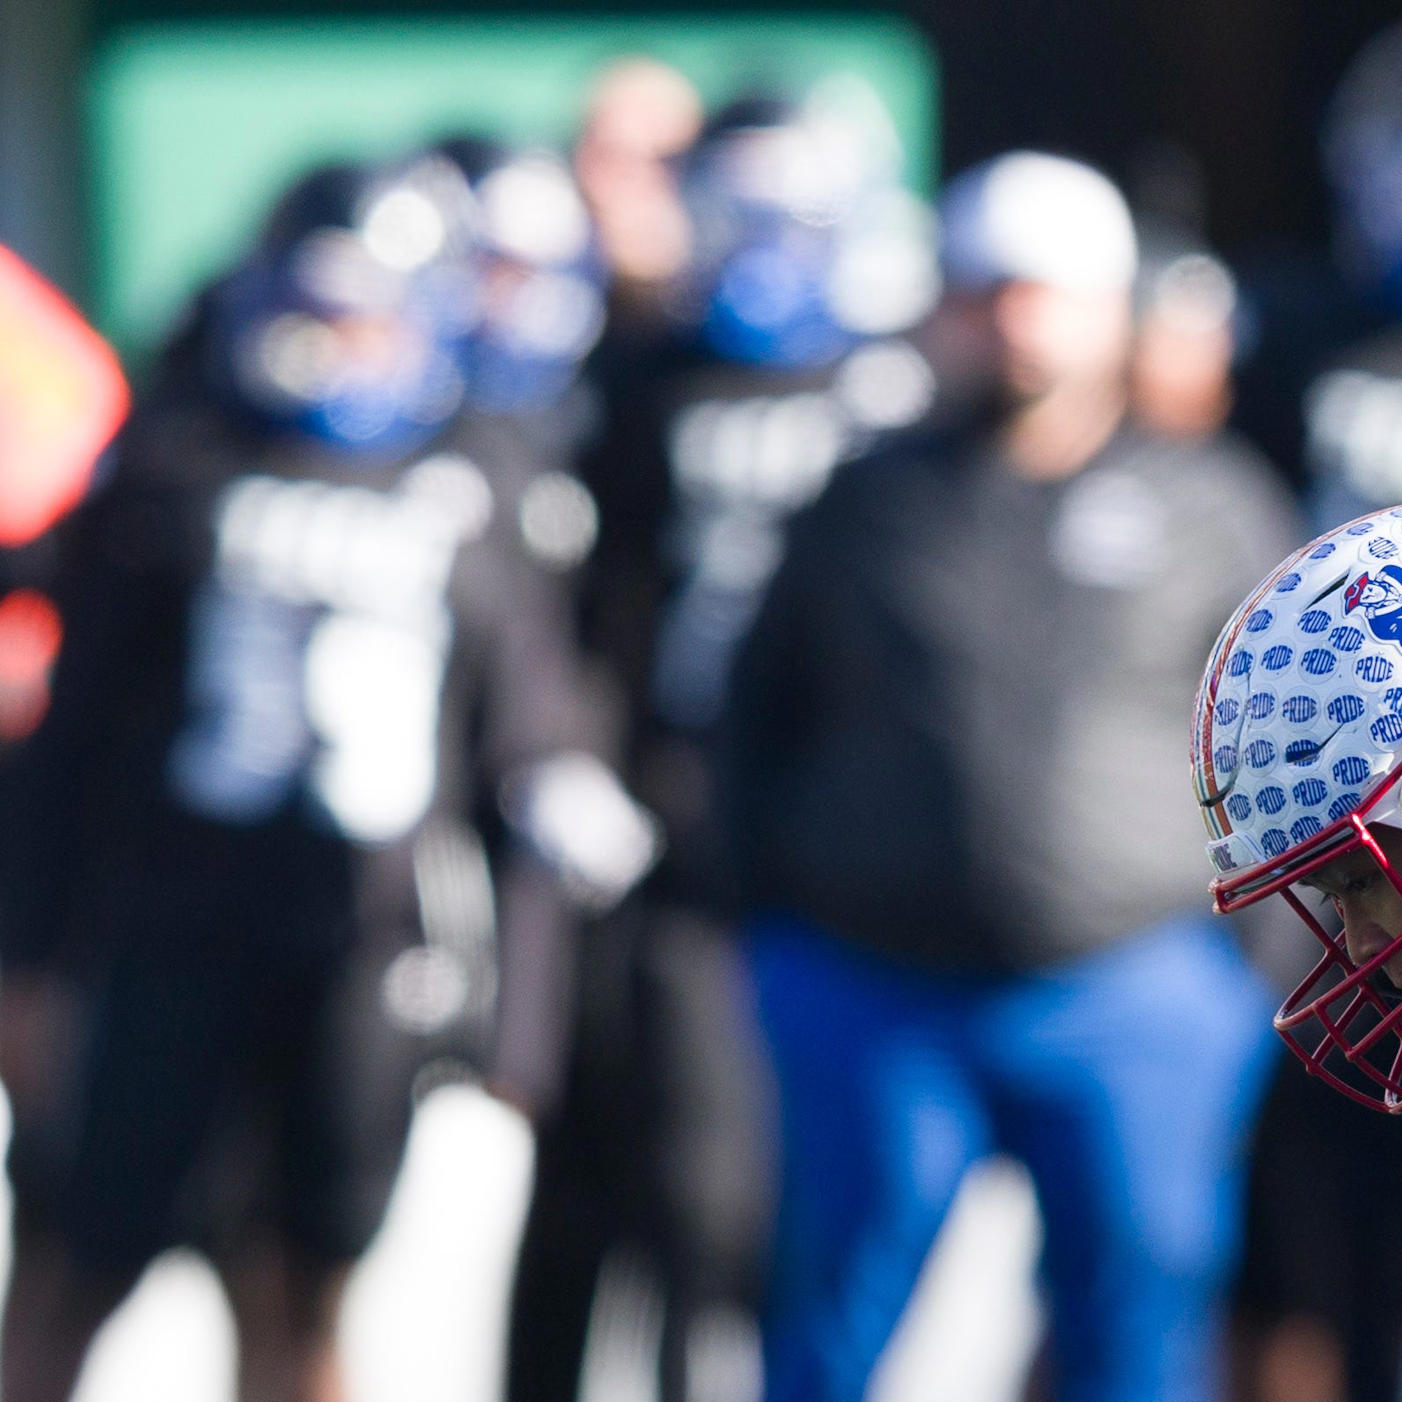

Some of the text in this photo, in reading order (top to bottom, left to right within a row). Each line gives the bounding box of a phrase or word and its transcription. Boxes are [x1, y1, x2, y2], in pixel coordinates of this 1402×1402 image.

[1297, 610, 1332, 633] PRIDE
[1328, 626, 1365, 652] PRIDE
[1261, 645, 1293, 670] PRIDE
[1300, 649, 1337, 674] PRIDE
[1356, 656, 1394, 682] PRIDE
[1282, 695, 1318, 723] PRIDE
[1327, 695, 1365, 723] PRIDE
[1332, 756, 1370, 785] PRIDE
[1256, 786, 1287, 815] PRIDE
[1292, 778, 1328, 807] PRIDE
